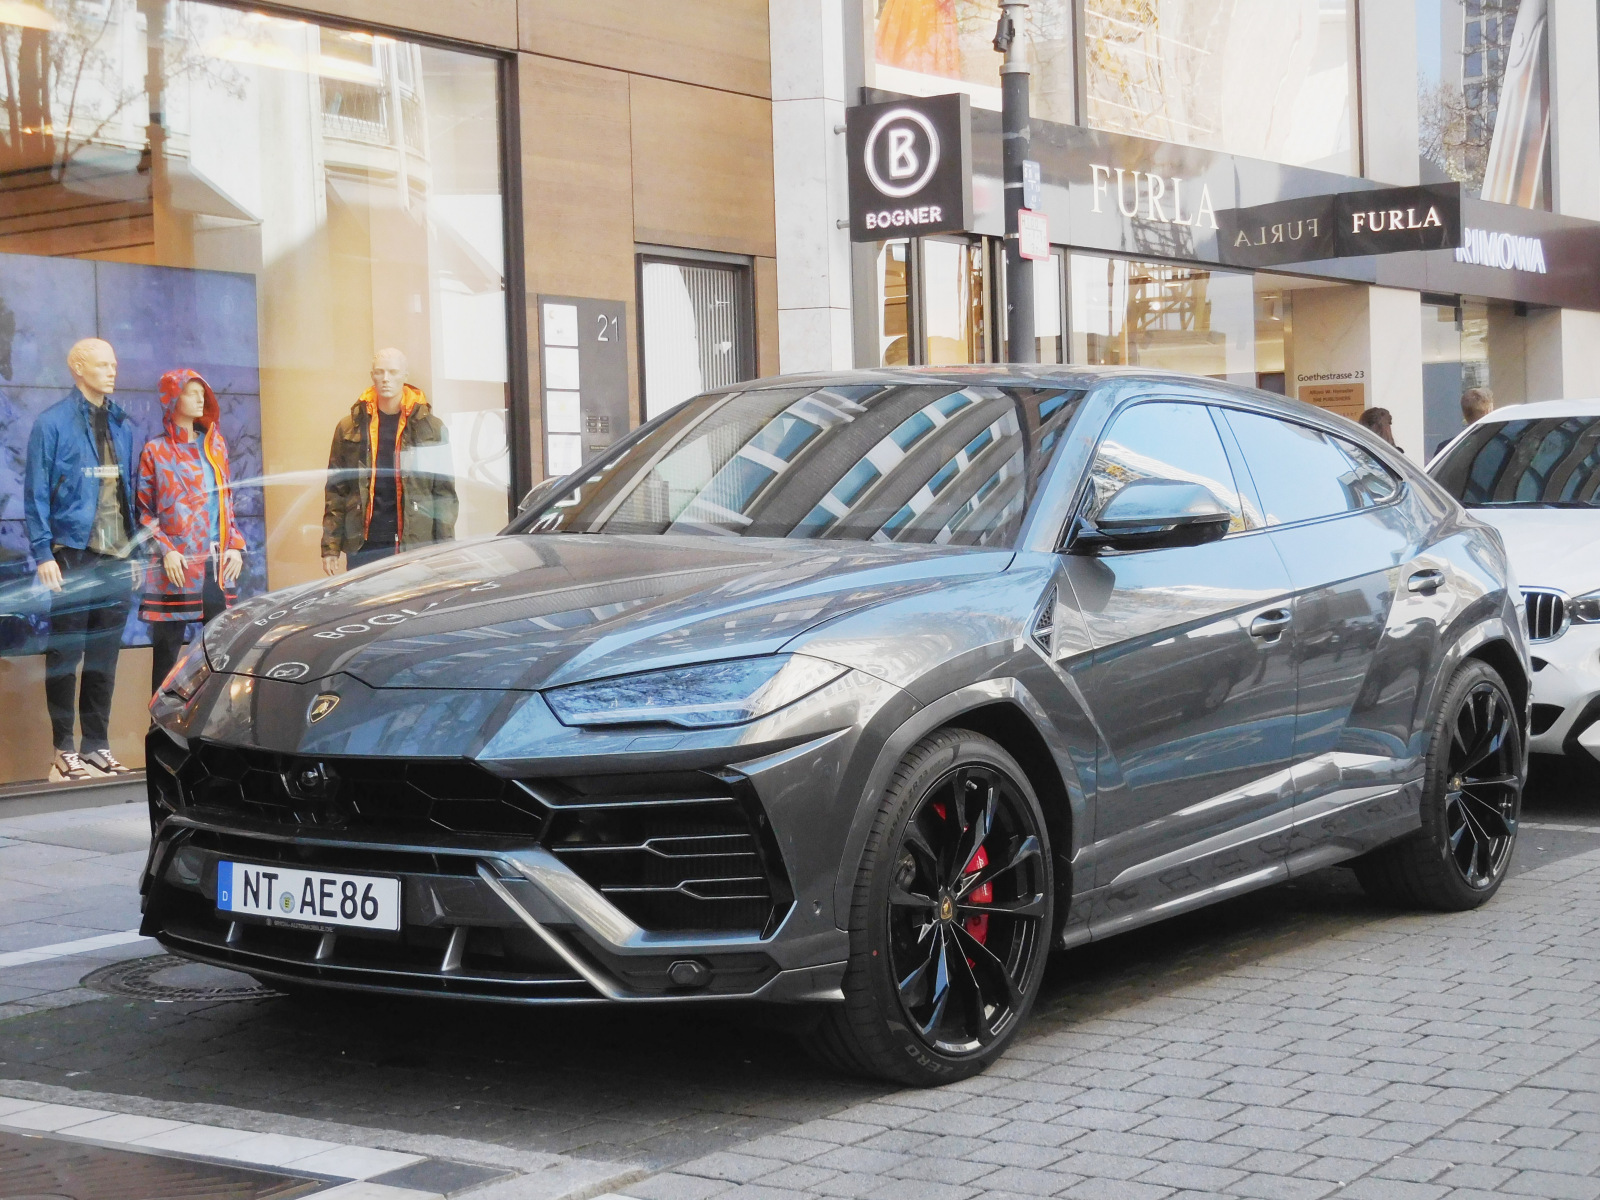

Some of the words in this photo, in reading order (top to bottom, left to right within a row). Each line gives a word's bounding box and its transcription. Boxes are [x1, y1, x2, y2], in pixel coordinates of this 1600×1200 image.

[1089, 163, 1220, 230] FURLA
[865, 205, 943, 230] BOGNER
[1351, 206, 1442, 234] FURLA
[1455, 227, 1547, 275] RIMOWA
[597, 313, 620, 343] 21
[1297, 372, 1353, 382] Goethestrasse
[1354, 370, 1365, 379] 23
[222, 890, 229, 902] D
[243, 869, 279, 911] NT
[299, 877, 379, 922] AE86
